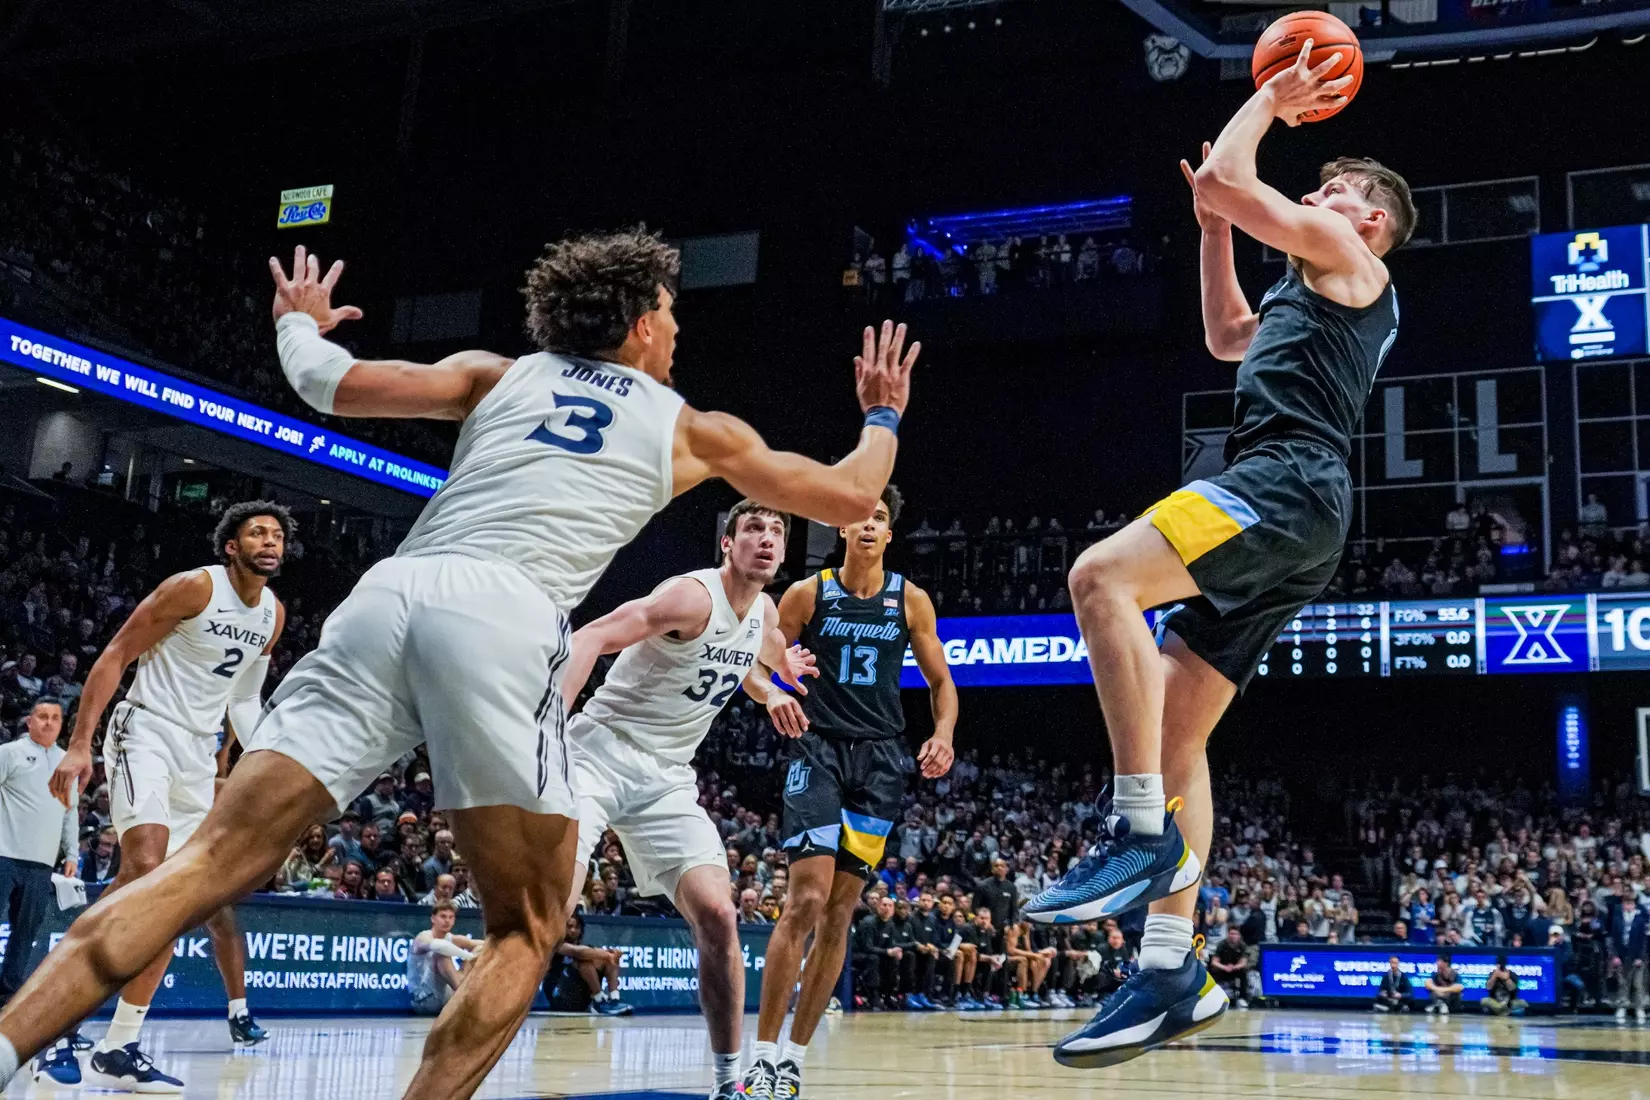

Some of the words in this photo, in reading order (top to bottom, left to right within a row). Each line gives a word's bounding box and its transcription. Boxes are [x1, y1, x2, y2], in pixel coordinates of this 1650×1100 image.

[1550, 270, 1630, 293] TriHealth
[561, 365, 634, 398] JONES
[10, 335, 92, 376] TOGETHER
[96, 363, 121, 386] WE
[124, 373, 158, 399] WILL
[161, 386, 195, 410] FIND
[198, 398, 236, 424] YOUR
[236, 411, 273, 436] NEXT
[274, 425, 304, 447] JOB!
[329, 443, 366, 466] APPLY
[368, 457, 386, 473] AT
[385, 462, 444, 491] PROLINKST
[523, 390, 614, 455] 3
[203, 620, 267, 648] XAVIER
[820, 616, 901, 642] Marquette
[212, 647, 244, 678] 2
[700, 643, 754, 667] XAVIER
[838, 644, 879, 686] 13
[1291, 648, 1303, 660] 0
[1325, 647, 1337, 659] 0
[1360, 646, 1372, 658] 0
[1257, 663, 1269, 676] 0
[1291, 662, 1303, 675] 0
[1325, 661, 1337, 674] 0
[681, 668, 739, 708] 32
[245, 932, 325, 961] WE'RE
[602, 945, 654, 969] E'RE
[656, 947, 699, 969] HIRIN
